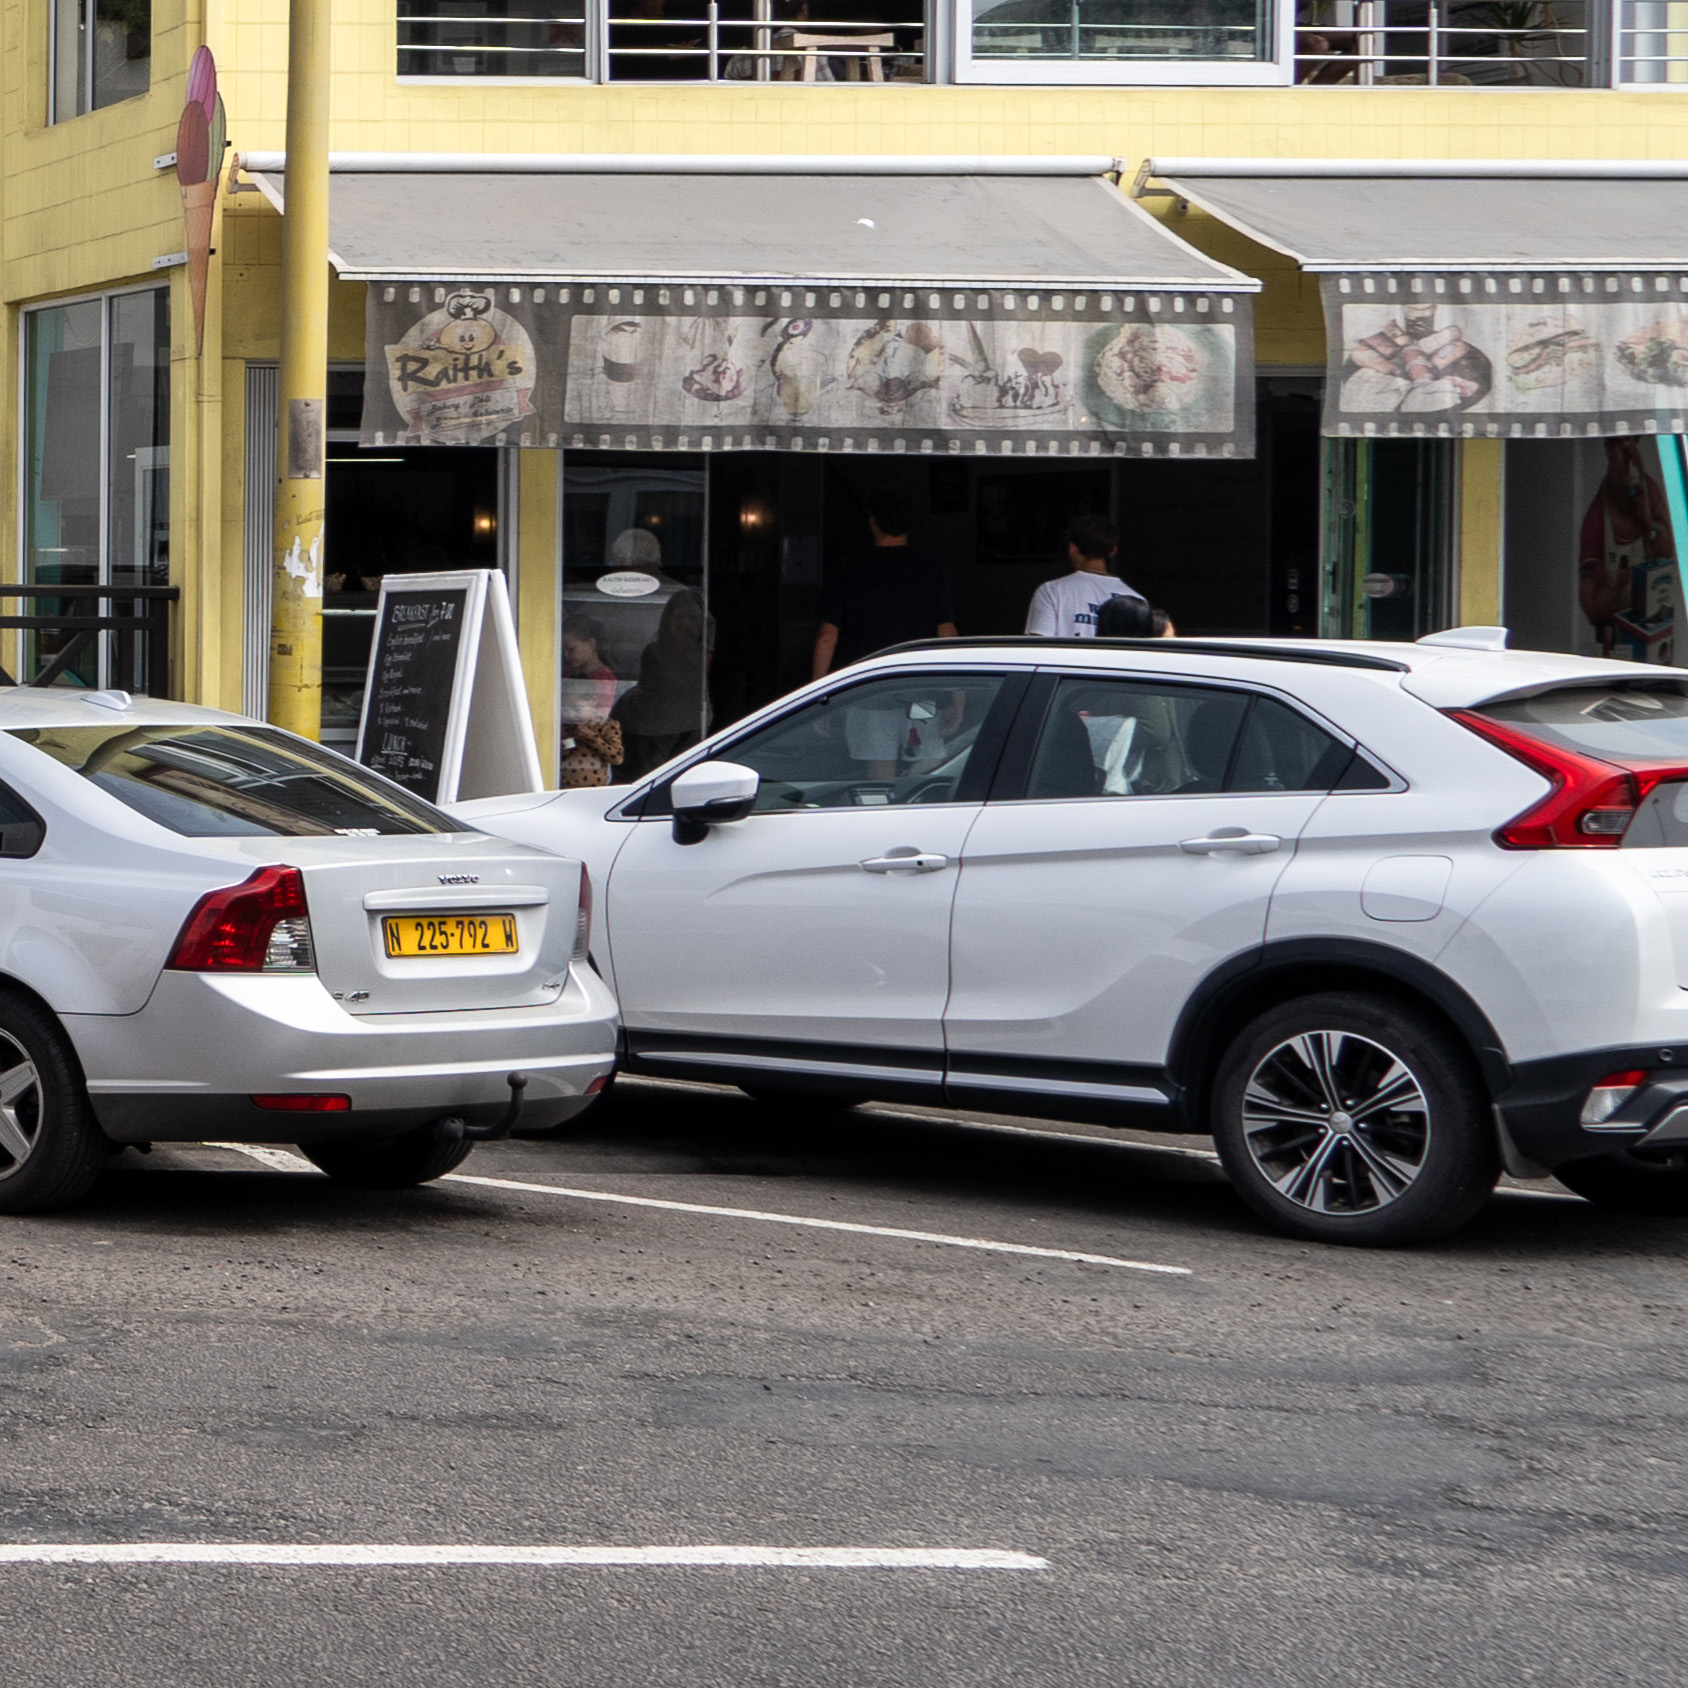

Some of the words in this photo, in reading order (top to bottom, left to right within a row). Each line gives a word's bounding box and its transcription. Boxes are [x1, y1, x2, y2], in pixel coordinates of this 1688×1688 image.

[395, 348, 523, 393] Raith's
[388, 922, 402, 952] N
[501, 918, 514, 948] W
